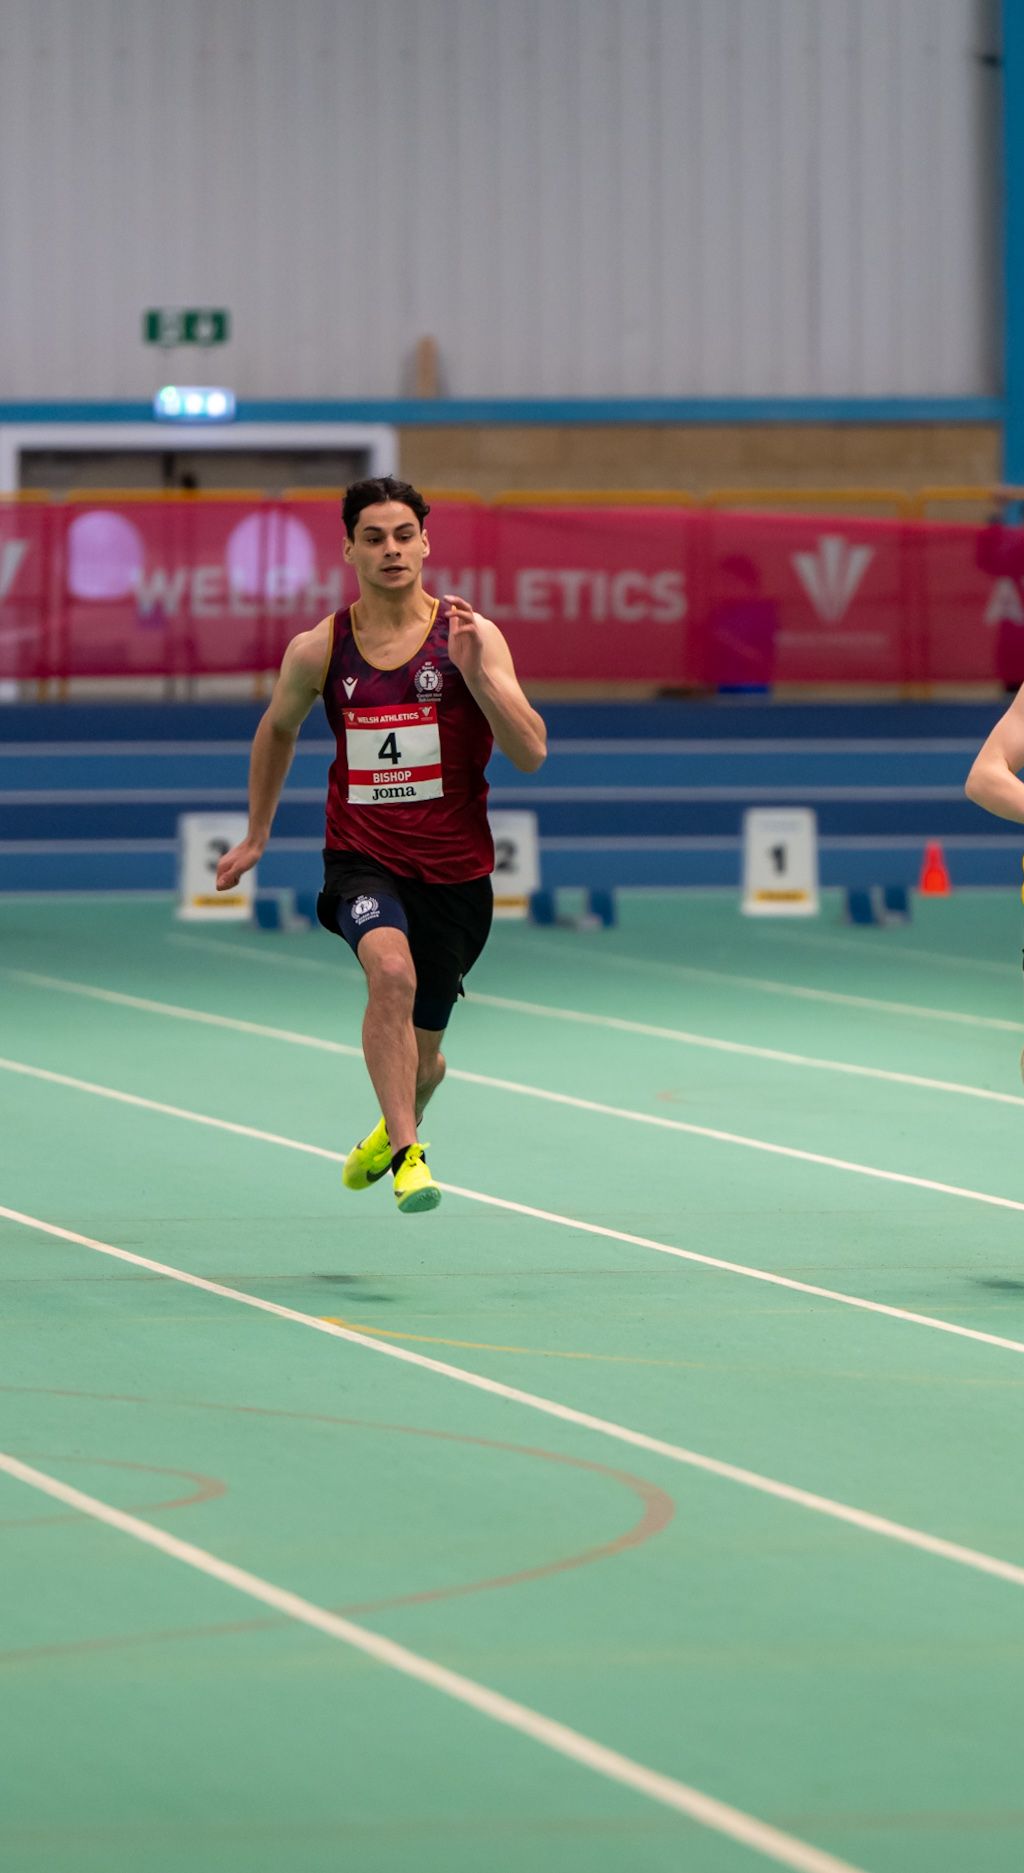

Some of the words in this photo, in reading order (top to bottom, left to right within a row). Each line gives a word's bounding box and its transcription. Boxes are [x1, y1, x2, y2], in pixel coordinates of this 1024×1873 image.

[134, 565, 343, 617] WELSH
[420, 567, 688, 622] HLETICS
[357, 715, 380, 724] WELSH
[380, 712, 420, 723] ATHLETICS
[378, 731, 402, 765] 4
[372, 770, 412, 784] BISHOP
[494, 838, 518, 875] 2
[768, 842, 787, 876] 1
